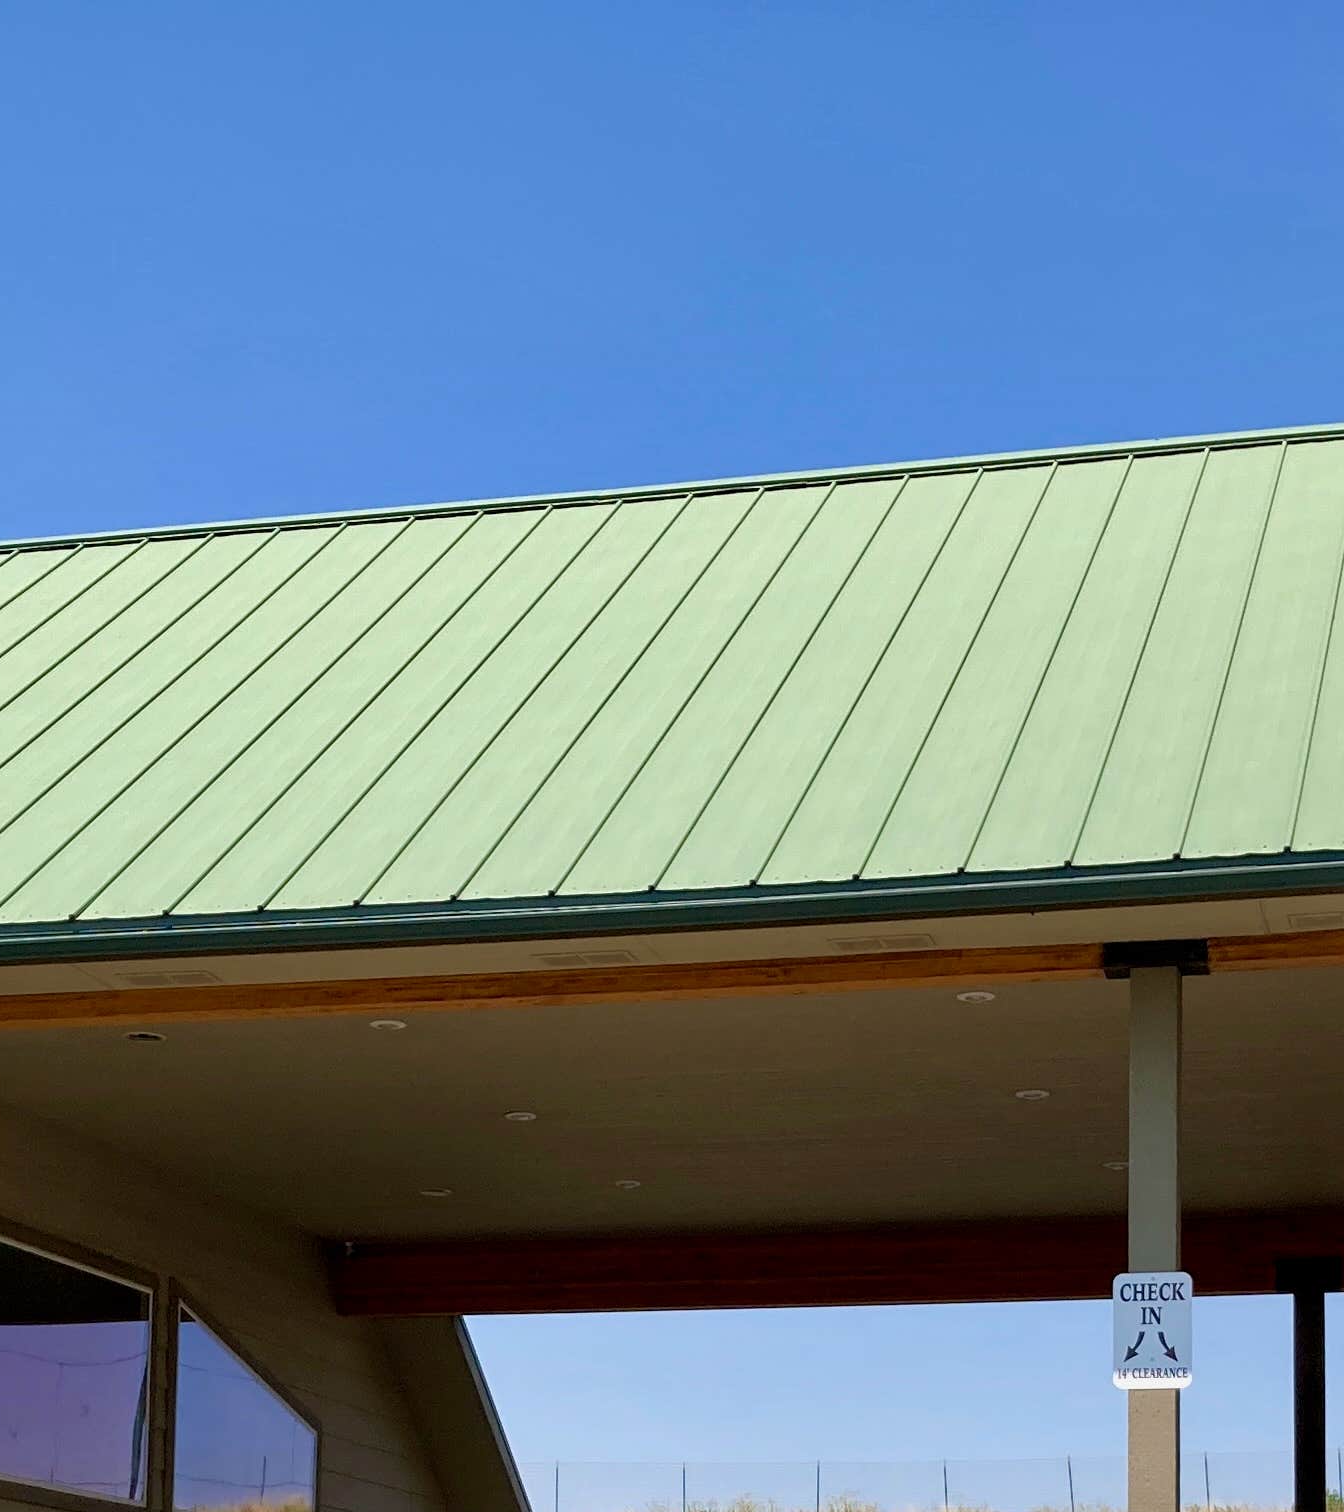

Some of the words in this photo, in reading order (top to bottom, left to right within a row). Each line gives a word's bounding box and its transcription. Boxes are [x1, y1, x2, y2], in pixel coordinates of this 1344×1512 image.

[1120, 1283, 1185, 1302] CHECK
[1141, 1307, 1163, 1325] IN
[1132, 1367, 1188, 1379] CLEARANCE
